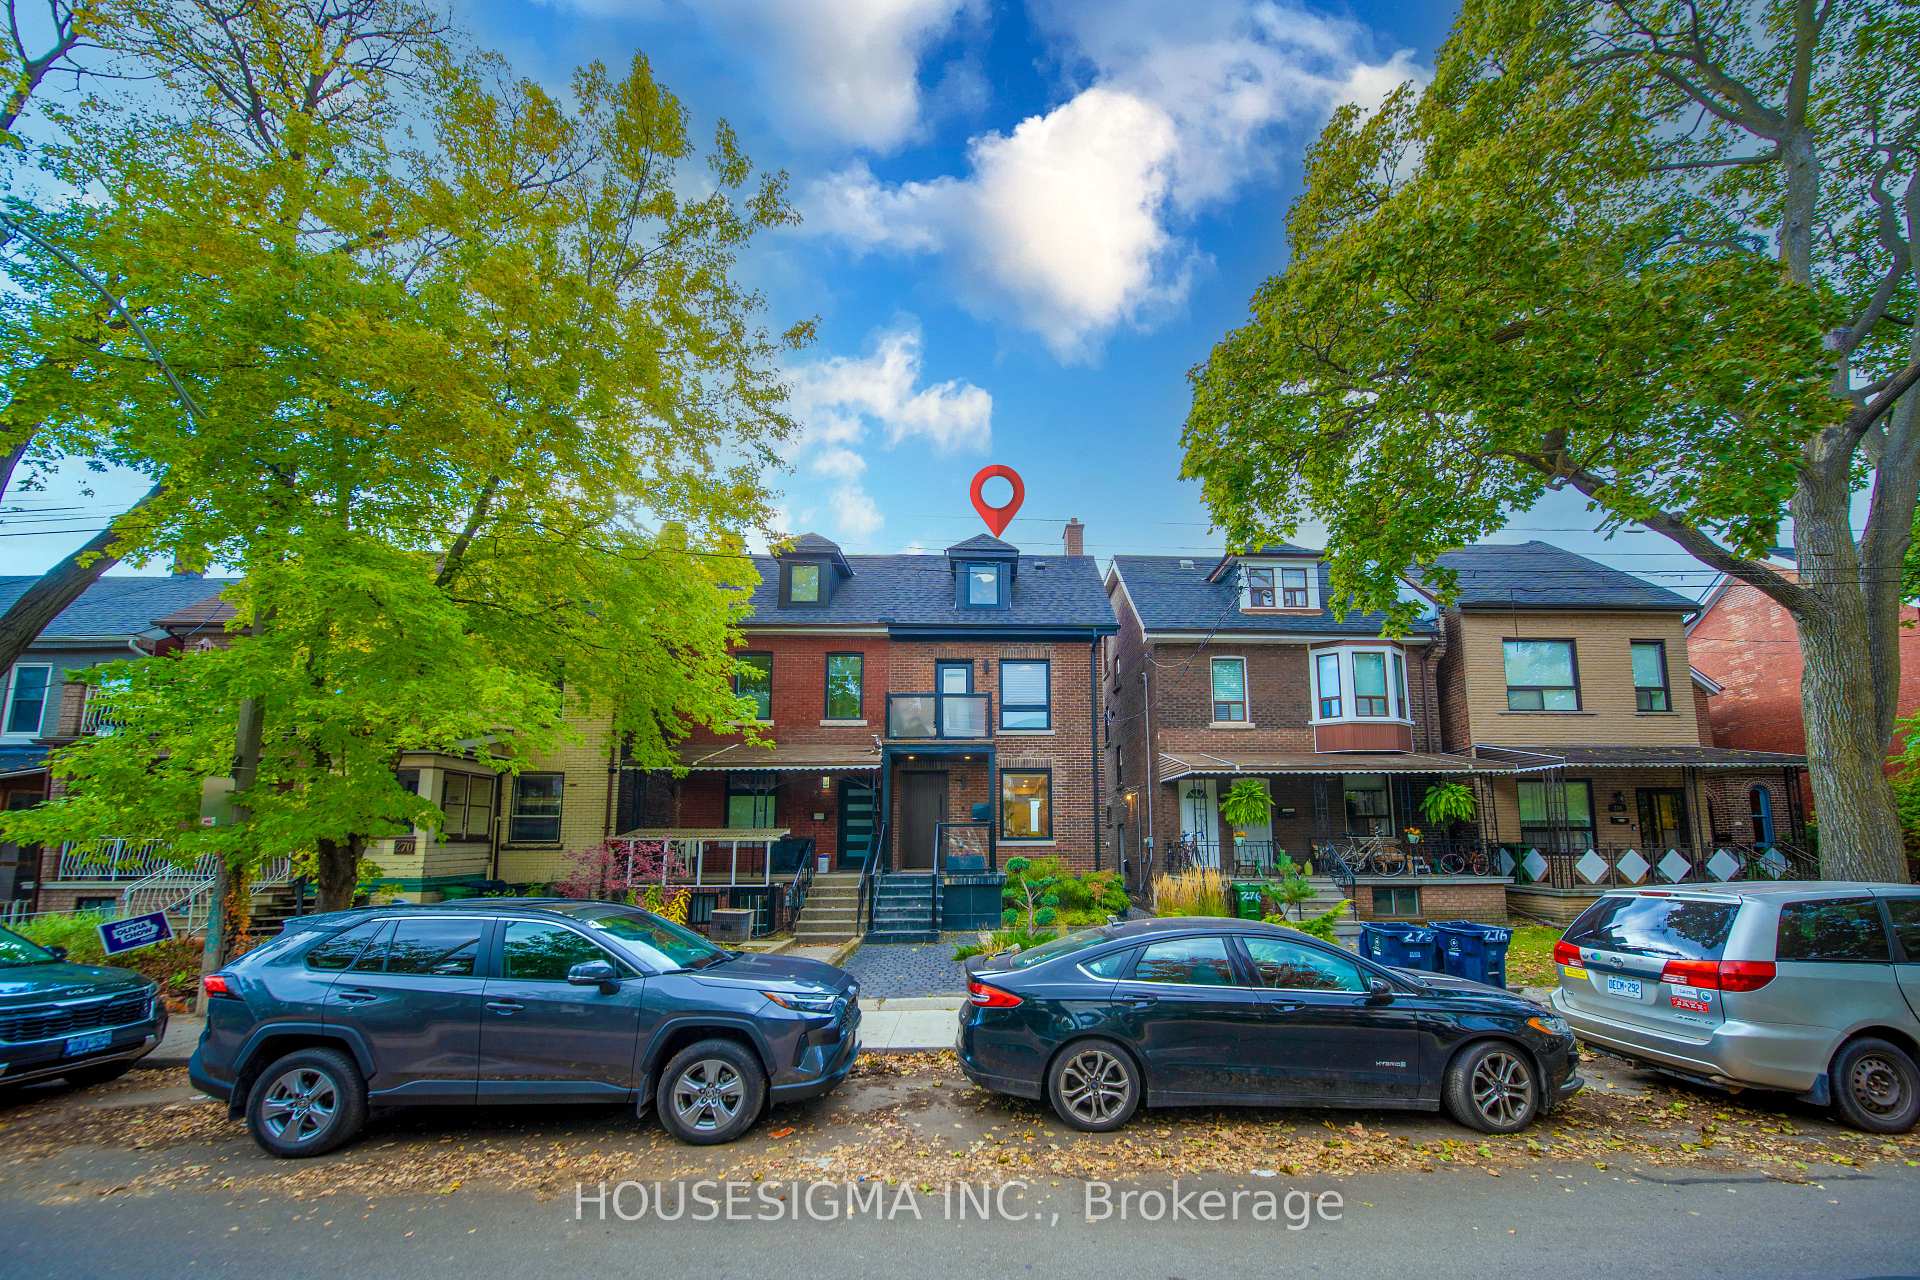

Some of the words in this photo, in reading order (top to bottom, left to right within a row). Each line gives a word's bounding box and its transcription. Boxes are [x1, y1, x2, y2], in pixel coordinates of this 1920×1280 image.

[395, 841, 414, 852] 270
[1241, 891, 1262, 903] 276
[117, 922, 146, 936] OLIVIA
[124, 926, 153, 940] CHOW
[1483, 930, 1508, 942] 276
